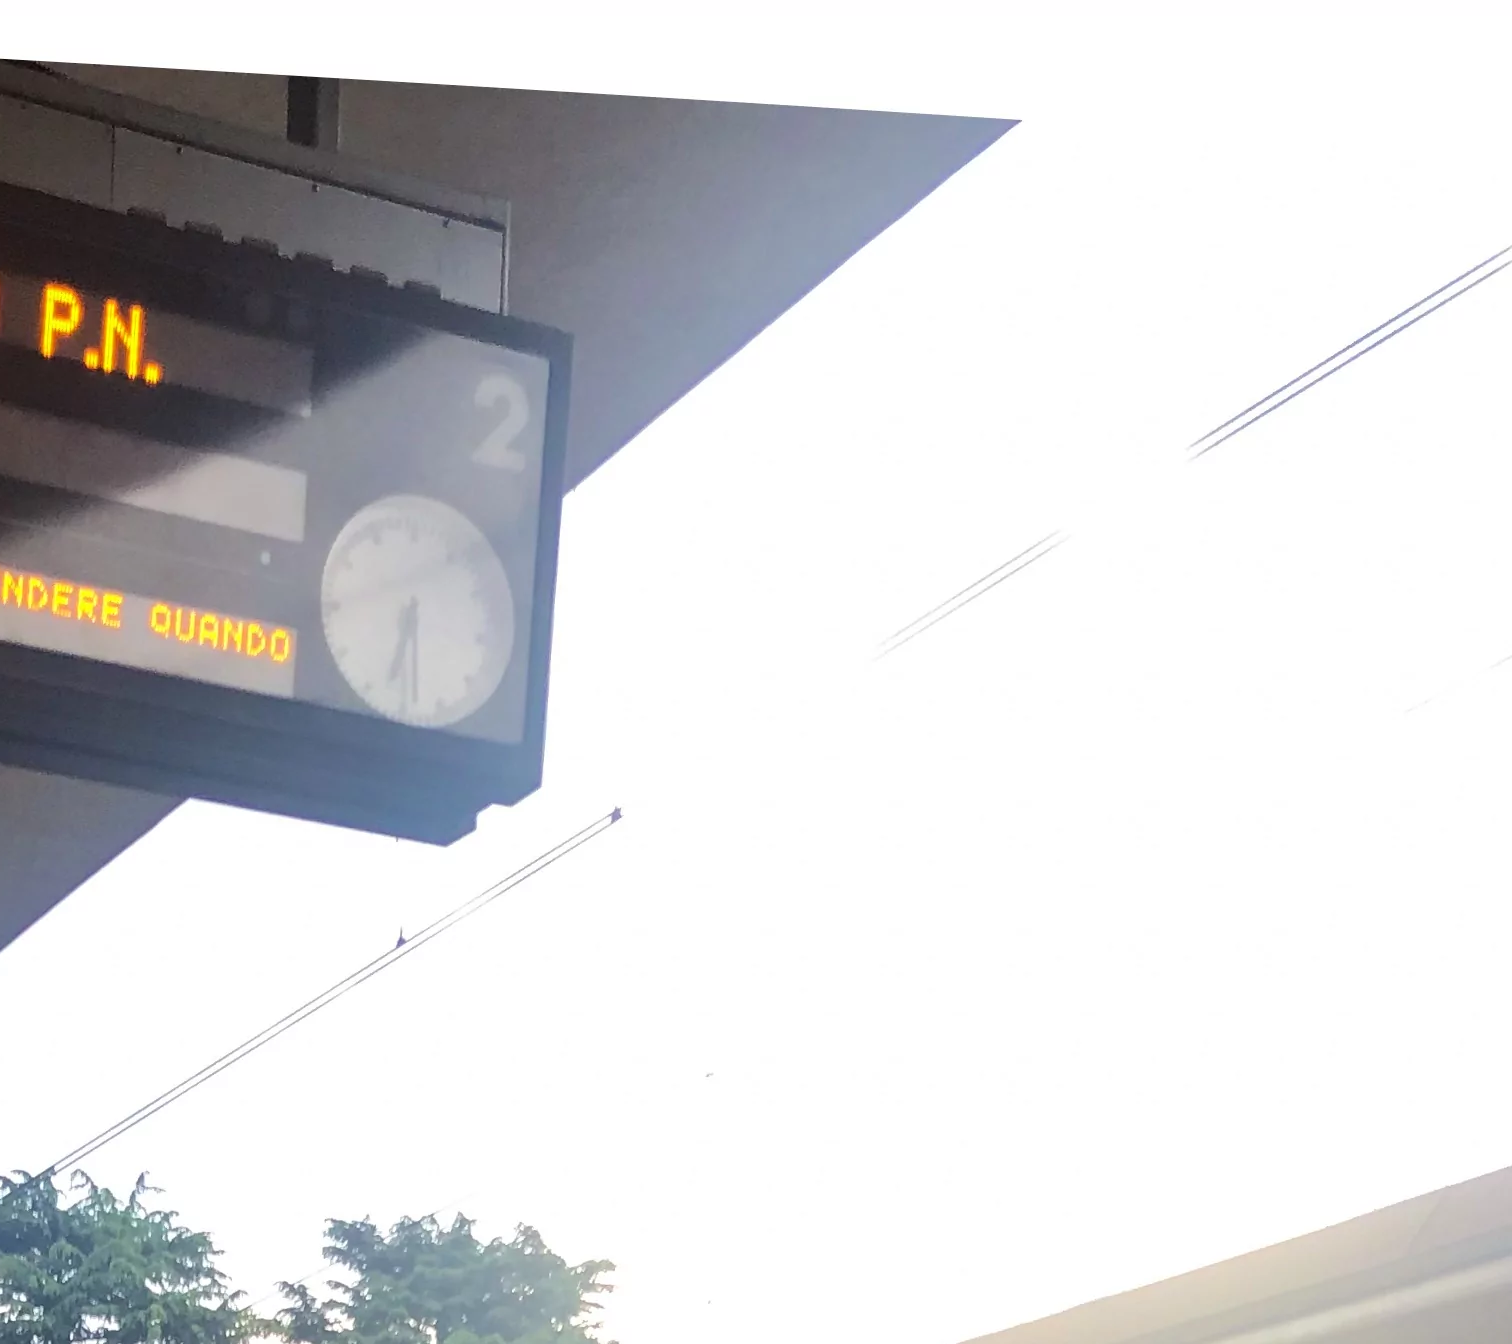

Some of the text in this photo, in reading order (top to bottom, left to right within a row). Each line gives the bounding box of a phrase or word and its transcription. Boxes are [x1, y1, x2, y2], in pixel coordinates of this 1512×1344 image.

[40, 281, 164, 387] P.N.
[470, 373, 529, 474] 2
[149, 600, 291, 663] QUANDO
